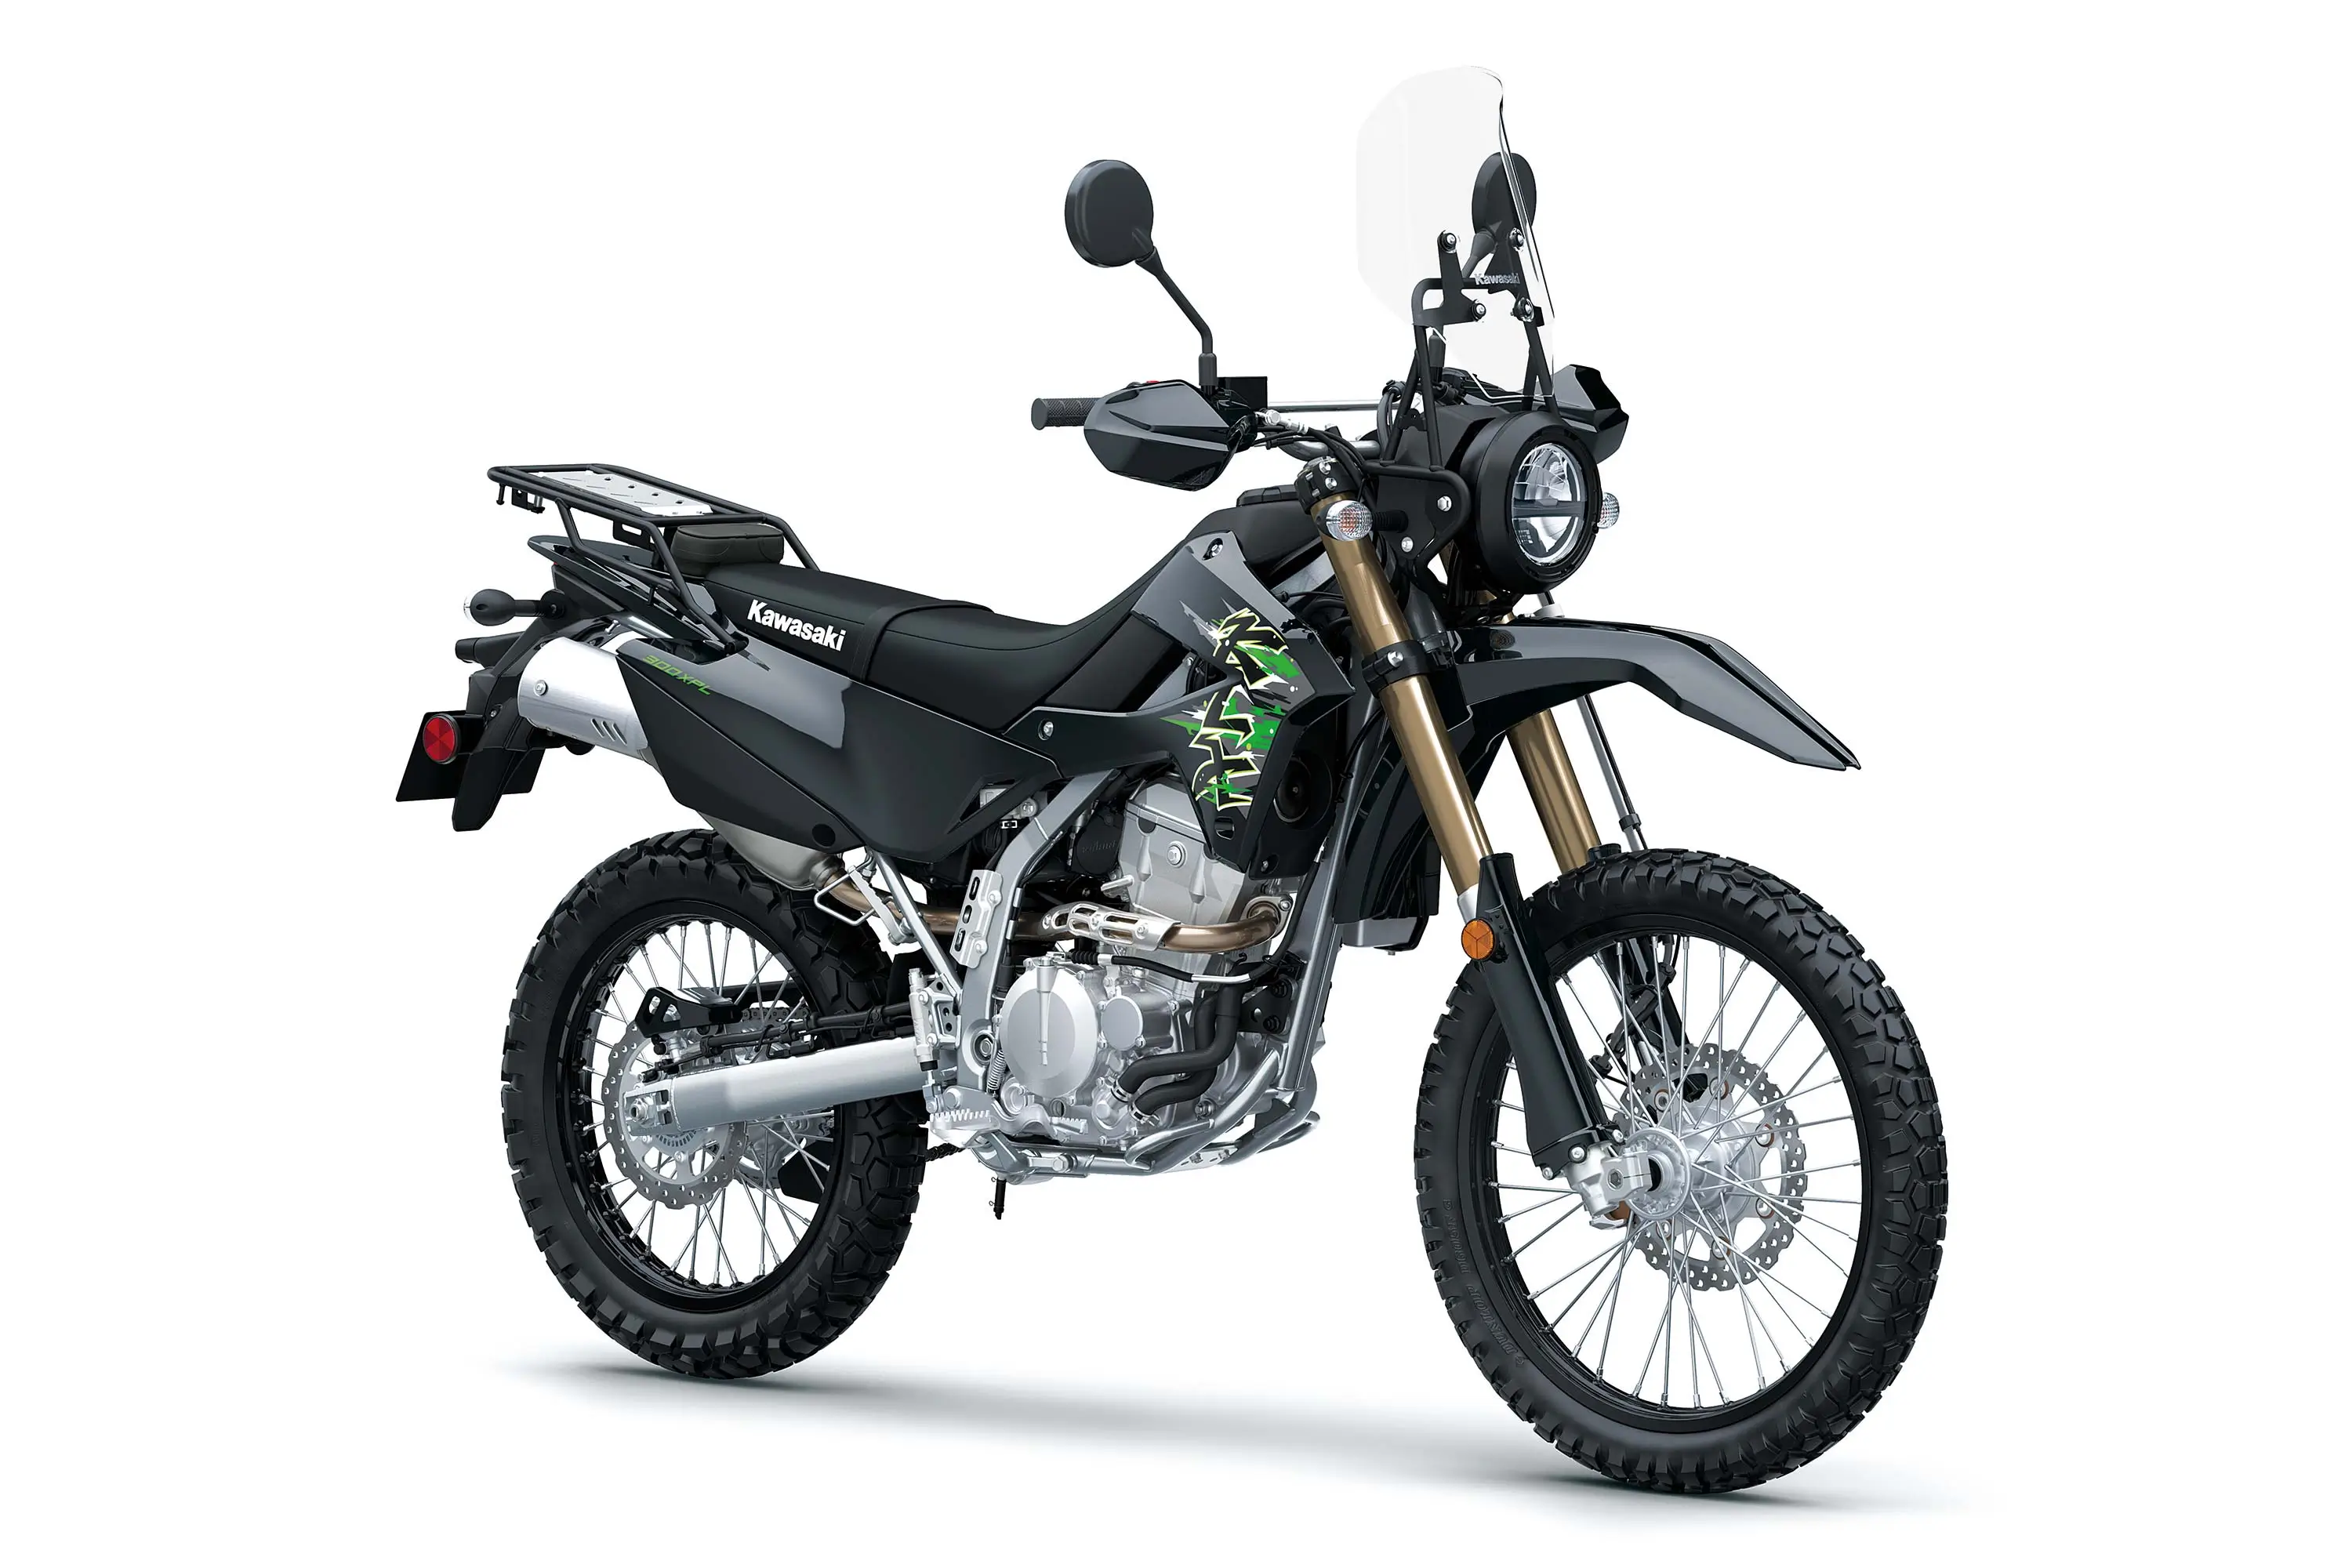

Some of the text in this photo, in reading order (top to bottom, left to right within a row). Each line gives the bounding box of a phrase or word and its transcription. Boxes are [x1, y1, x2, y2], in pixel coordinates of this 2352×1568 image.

[1474, 273, 1521, 285] Kawasaki
[747, 599, 847, 652] Kawasaki
[1465, 1284, 1518, 1355] DUNLOP
